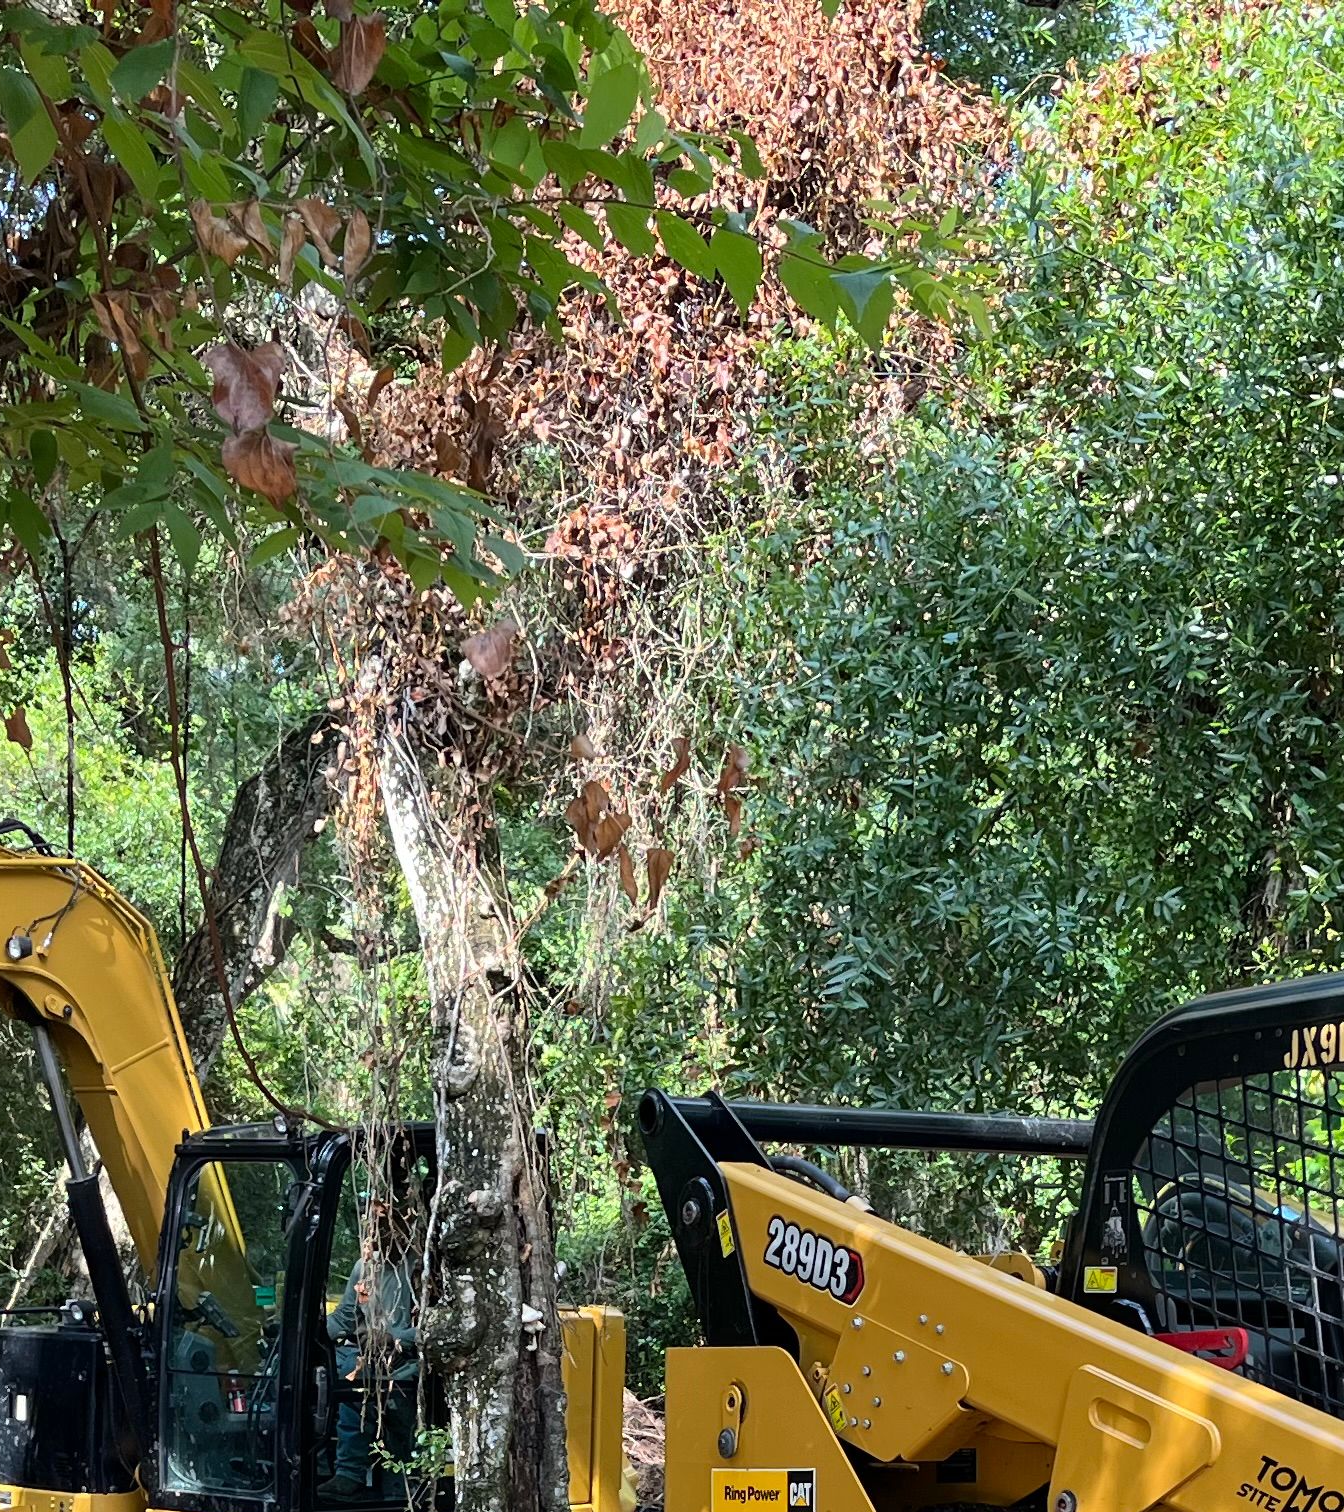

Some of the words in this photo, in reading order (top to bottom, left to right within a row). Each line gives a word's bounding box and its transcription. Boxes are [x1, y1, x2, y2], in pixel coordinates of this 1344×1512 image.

[764, 1218, 850, 1297] 289D3
[724, 1485, 746, 1504] Ring
[747, 1486, 781, 1501] Power
[789, 1482, 812, 1507] CAT
[1236, 1483, 1281, 1512] SITE
